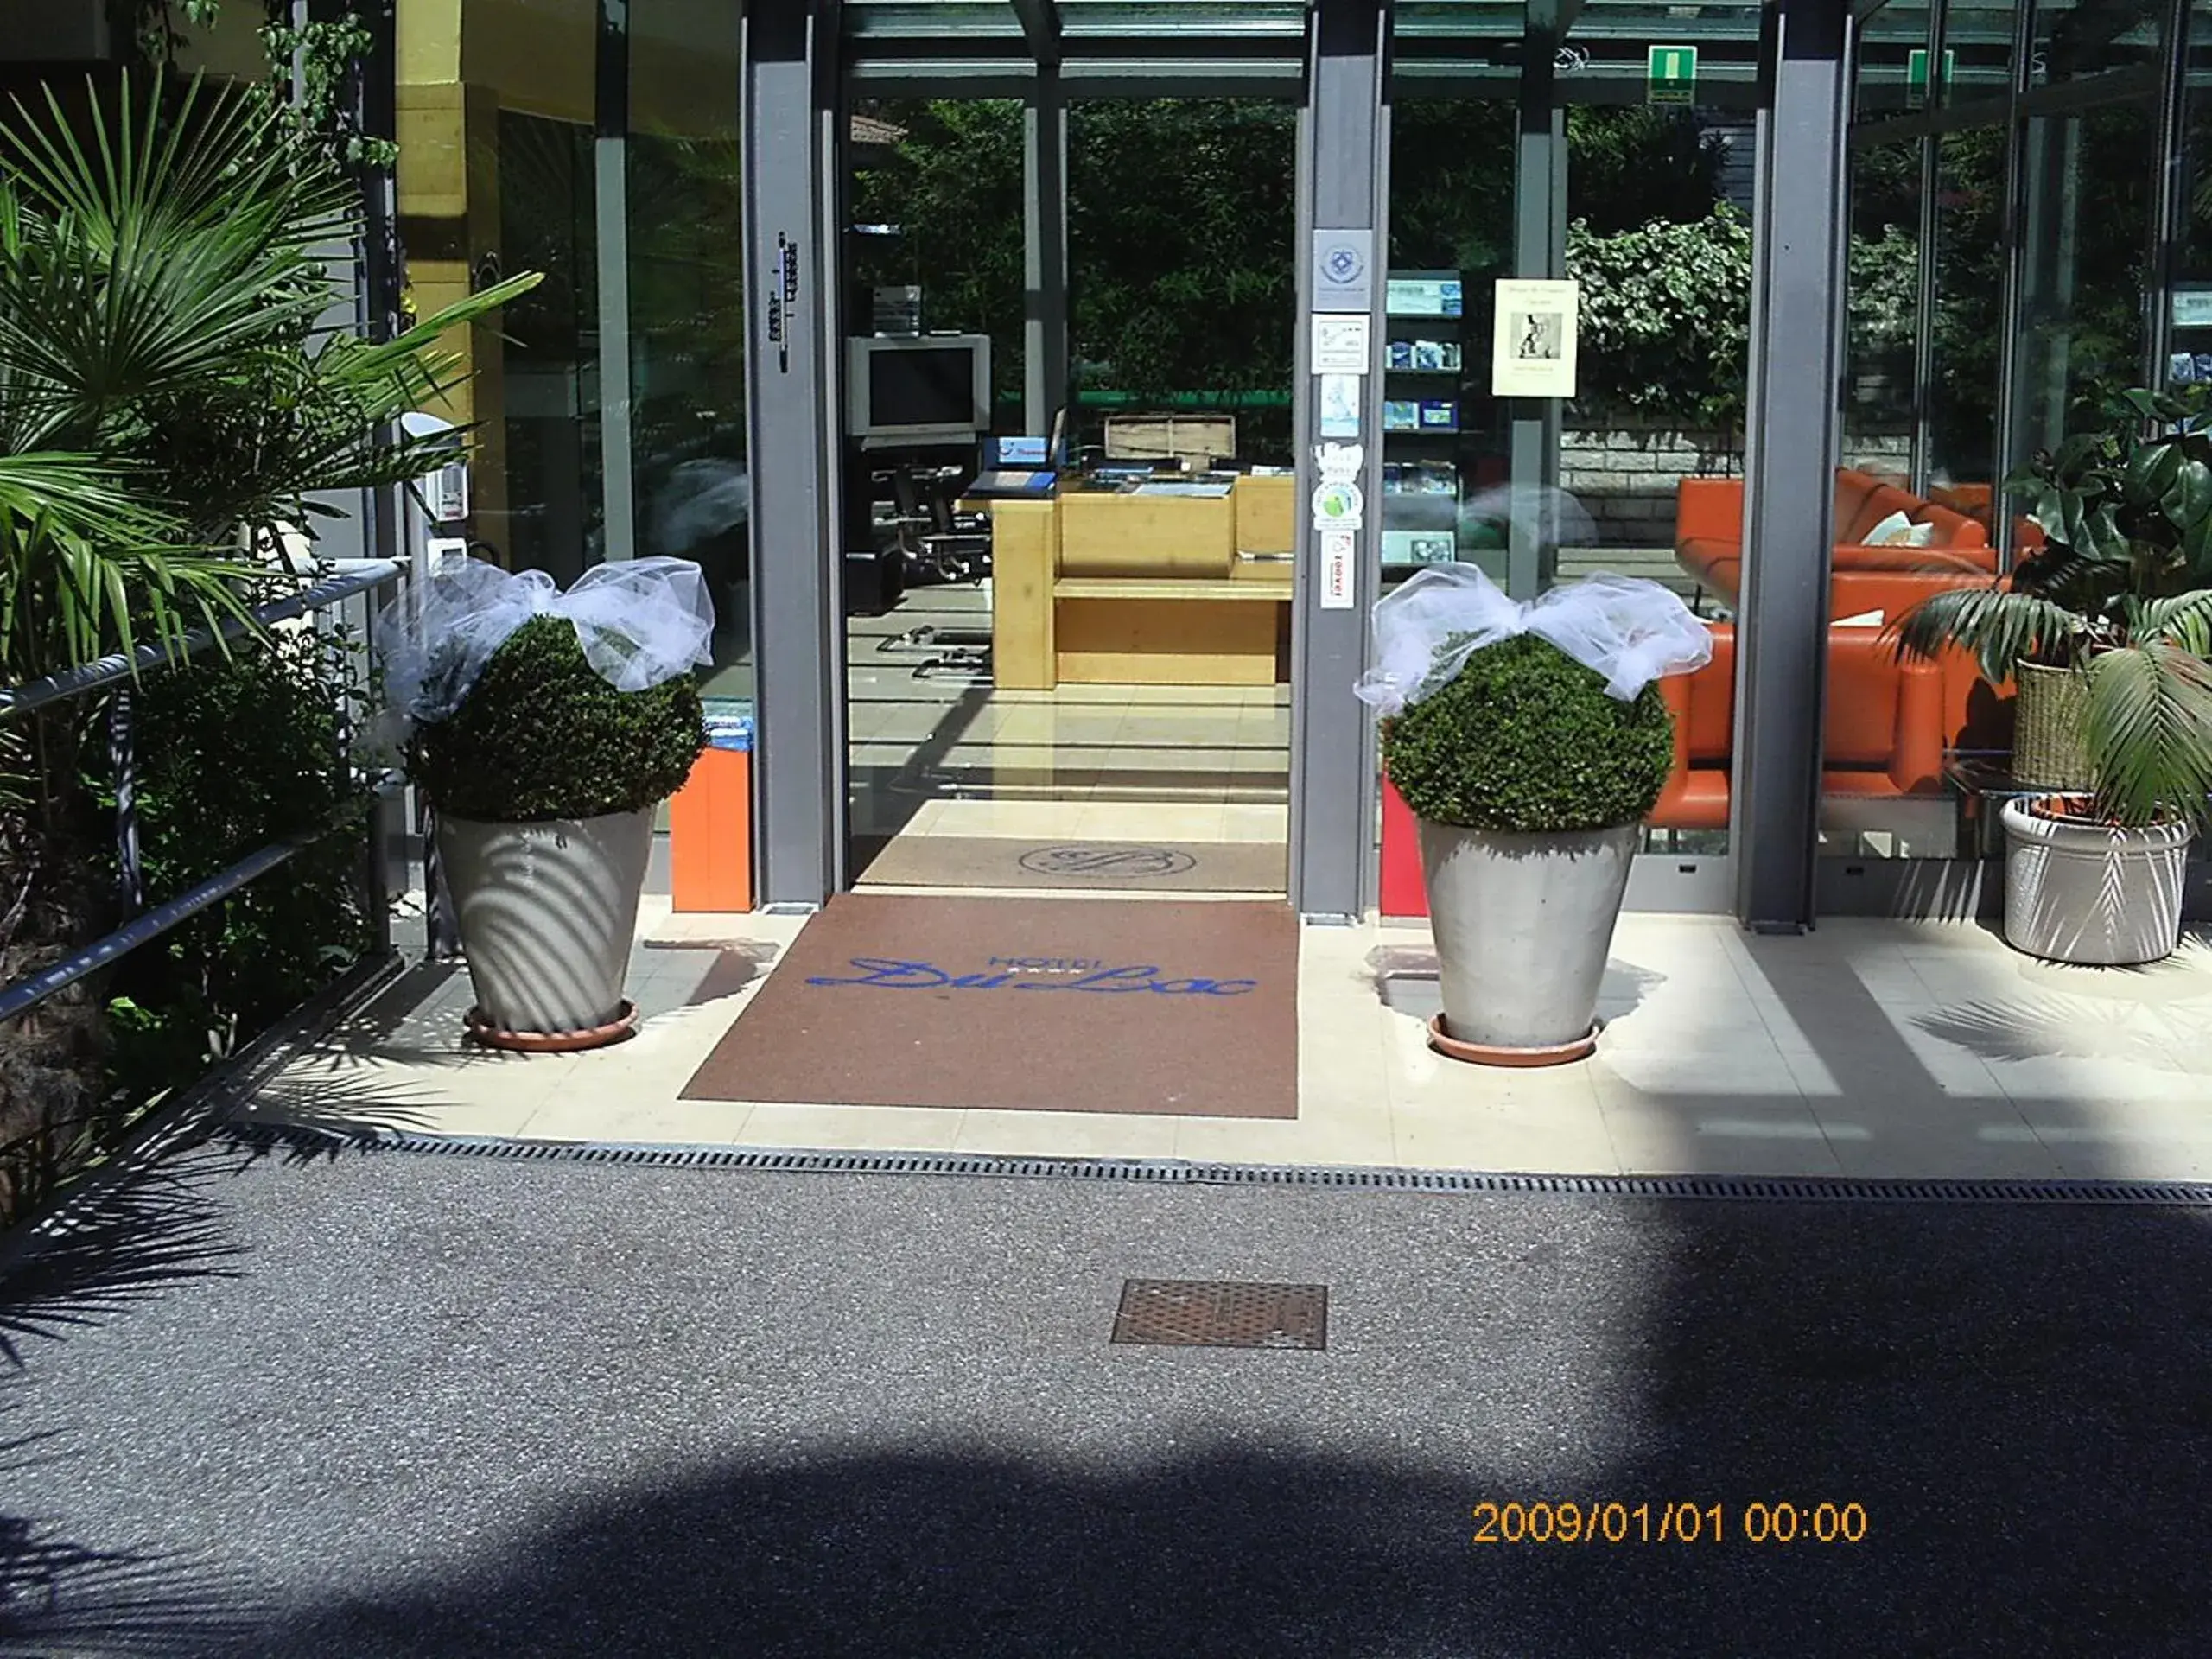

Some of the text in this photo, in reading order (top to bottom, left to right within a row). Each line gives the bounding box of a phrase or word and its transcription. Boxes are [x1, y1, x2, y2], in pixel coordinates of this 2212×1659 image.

[988, 957, 1102, 969] HOTEL
[805, 957, 1258, 995] Du Lac
